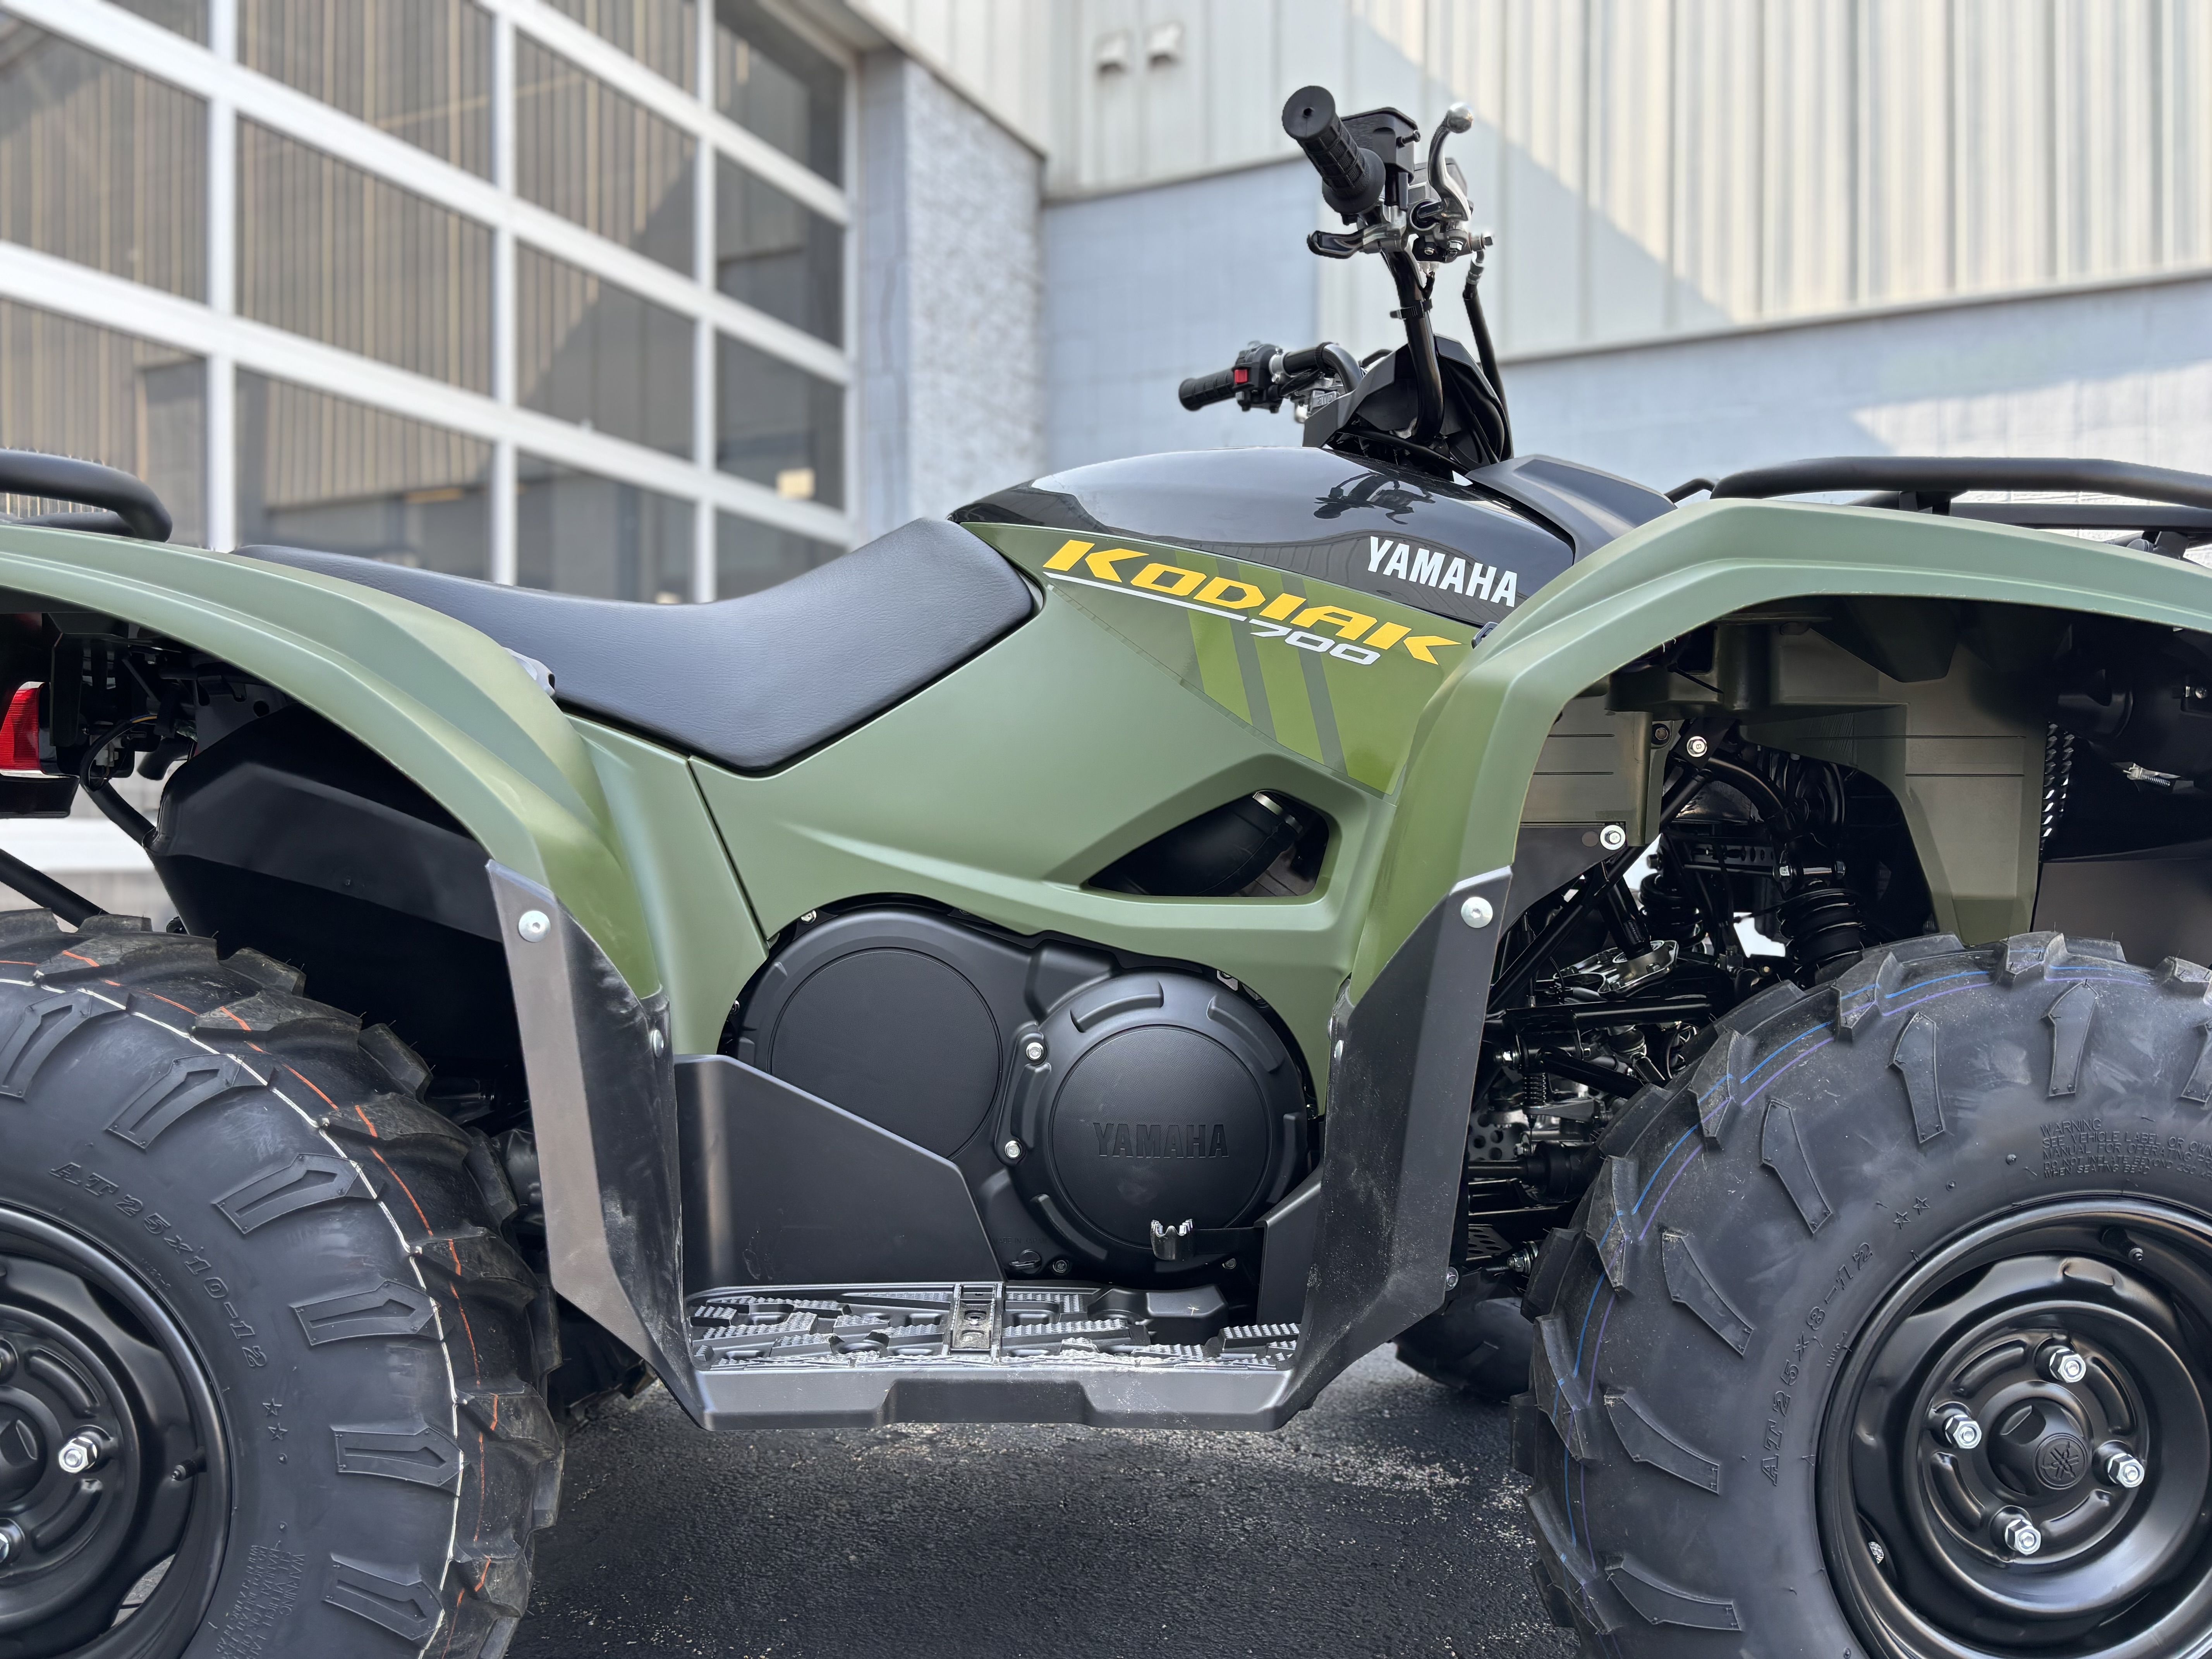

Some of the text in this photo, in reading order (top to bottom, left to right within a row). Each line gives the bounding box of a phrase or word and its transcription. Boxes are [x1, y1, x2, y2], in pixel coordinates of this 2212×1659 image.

[1367, 536, 1518, 608] YAMAHA
[1042, 539, 1462, 665] KODIAK
[1249, 618, 1382, 665] 700
[1093, 1123, 1229, 1158] YAMAHA
[2040, 1118, 2101, 1137] WARNING
[2042, 1135, 2065, 1149] SEE
[2071, 1131, 2120, 1144] VEHICLE
[2126, 1132, 2161, 1145] LABEL
[2168, 1137, 2185, 1149] OR
[2043, 1144, 2091, 1160] MANUAL
[2097, 1142, 2122, 1154] FOR
[2127, 1143, 2192, 1162] OPERATING
[2044, 1160, 2058, 1171] DO
[2063, 1156, 2083, 1167] NOT
[2088, 1155, 2130, 1164] INFLATE
[2135, 1155, 2173, 1169] BEYOND
[2044, 1164, 2150, 1178] WHEN SEATING BEAD
[279, 1554, 306, 1616] WARNING
